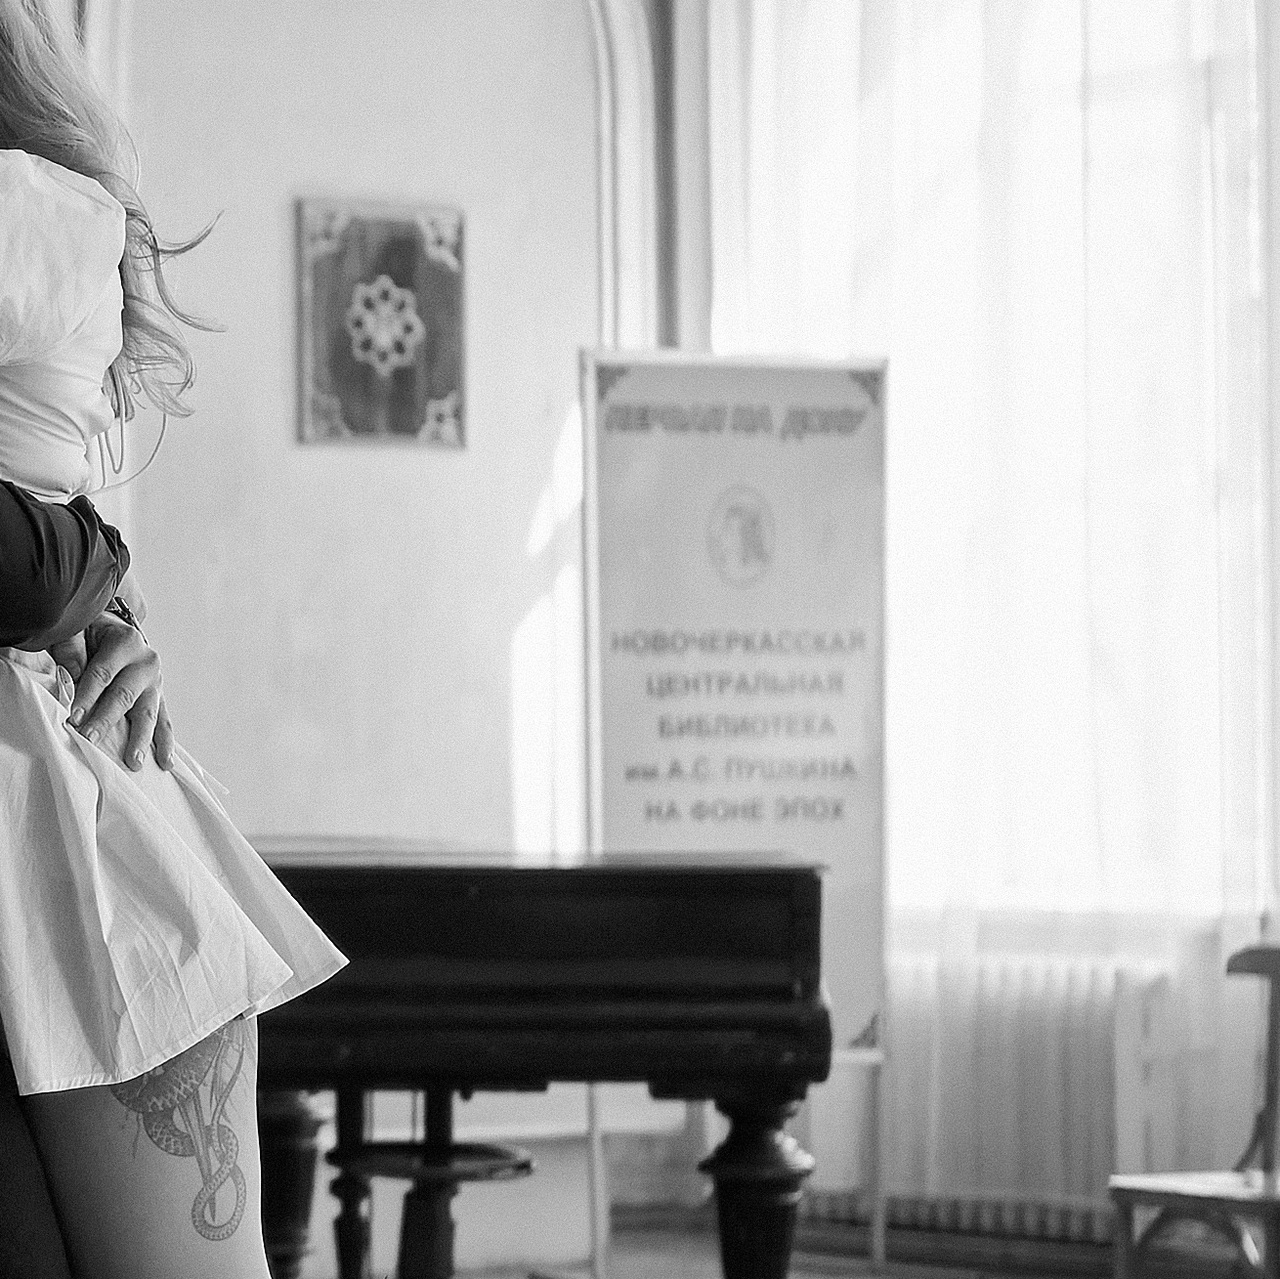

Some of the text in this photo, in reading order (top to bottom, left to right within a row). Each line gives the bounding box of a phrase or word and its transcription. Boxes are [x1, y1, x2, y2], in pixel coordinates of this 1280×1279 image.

[611, 629, 865, 655] НОВОЧЕРКАССКАЯ
[646, 671, 843, 699] ЦЕНТРАЛЬНАЯ
[658, 714, 836, 738] БИБЛИОТЕКА
[725, 756, 858, 783] ПУШКИНА
[645, 795, 845, 824] НА ФОНЕ ЭПОХ
